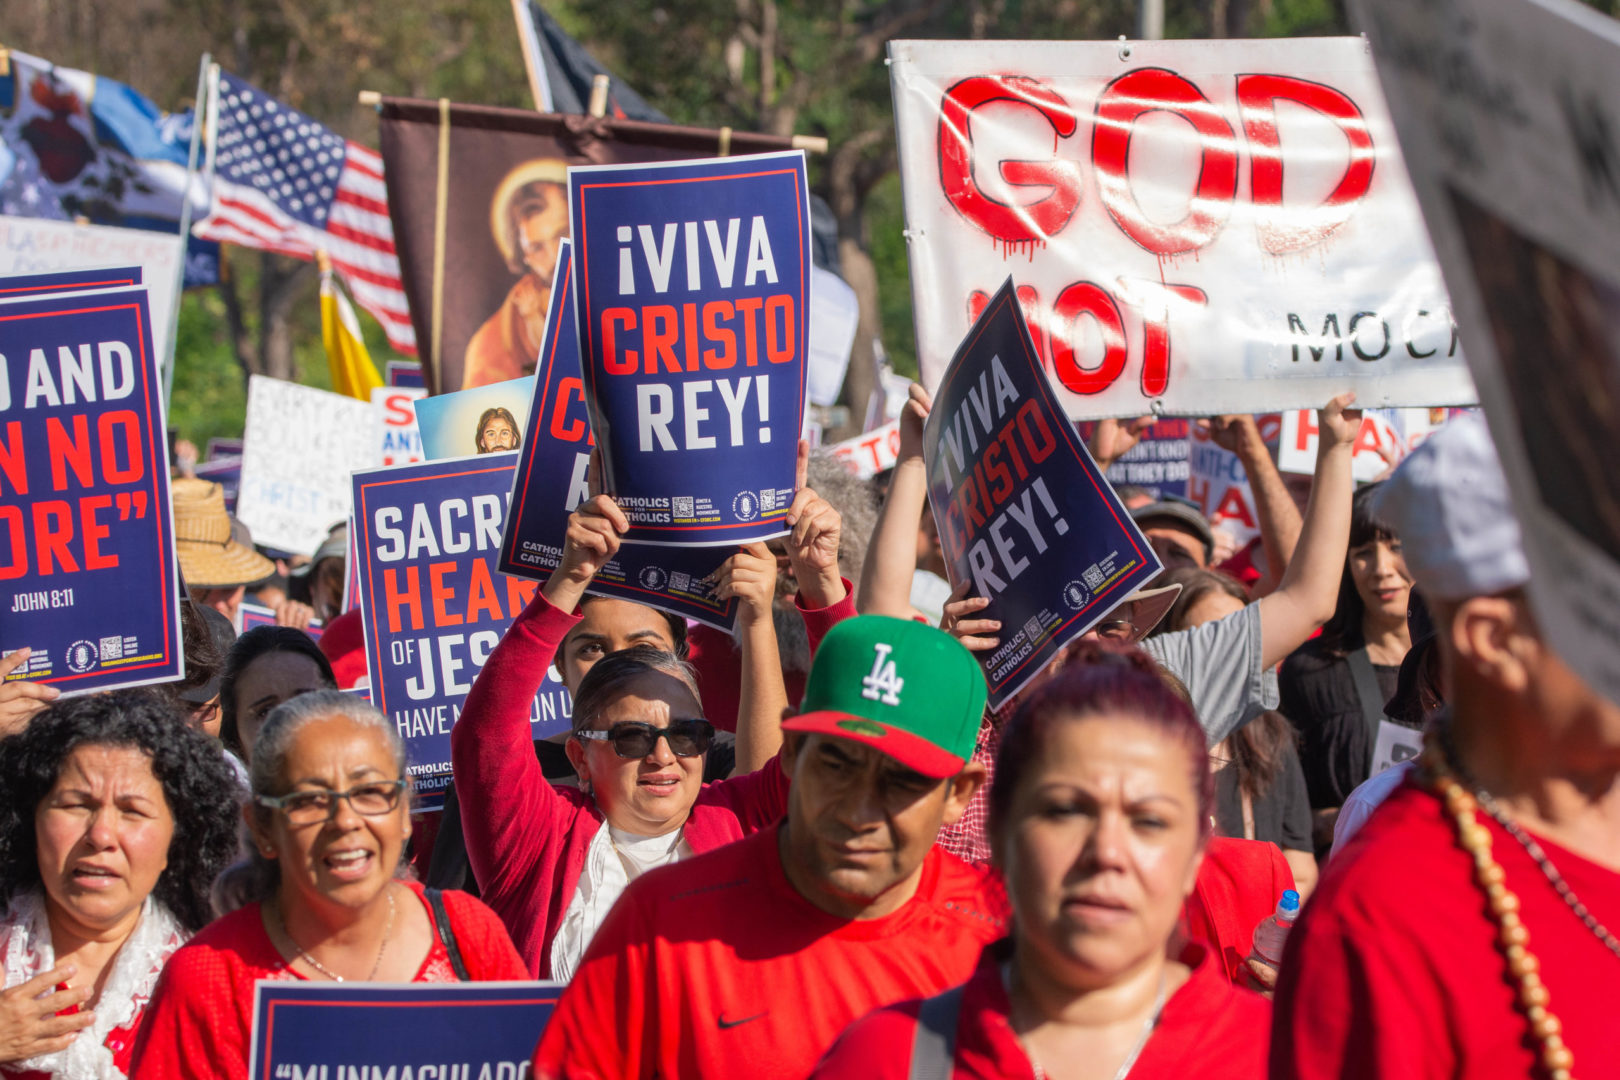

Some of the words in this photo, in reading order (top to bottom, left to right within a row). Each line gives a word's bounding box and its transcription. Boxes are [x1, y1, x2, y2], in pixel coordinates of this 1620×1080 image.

[937, 66, 1376, 256] GOD
[616, 215, 779, 295] ¡VIVA
[600, 294, 796, 376] CRISTO
[24, 340, 135, 409] AND
[46, 409, 145, 492] NO
[636, 374, 772, 452] REY!
[938, 353, 1020, 495] ¡VIVA
[945, 398, 1057, 563] CRISTO
[374, 491, 513, 563] SACR
[968, 475, 1070, 603] REY!
[11, 592, 49, 613] JOHN
[51, 588, 74, 608] 8:11
[391, 639, 415, 666] OF
[862, 642, 905, 706] LA
[985, 629, 1027, 670] CATHOLICS
[992, 642, 1034, 682] CATHOLICS
[395, 704, 451, 739] HAVE
